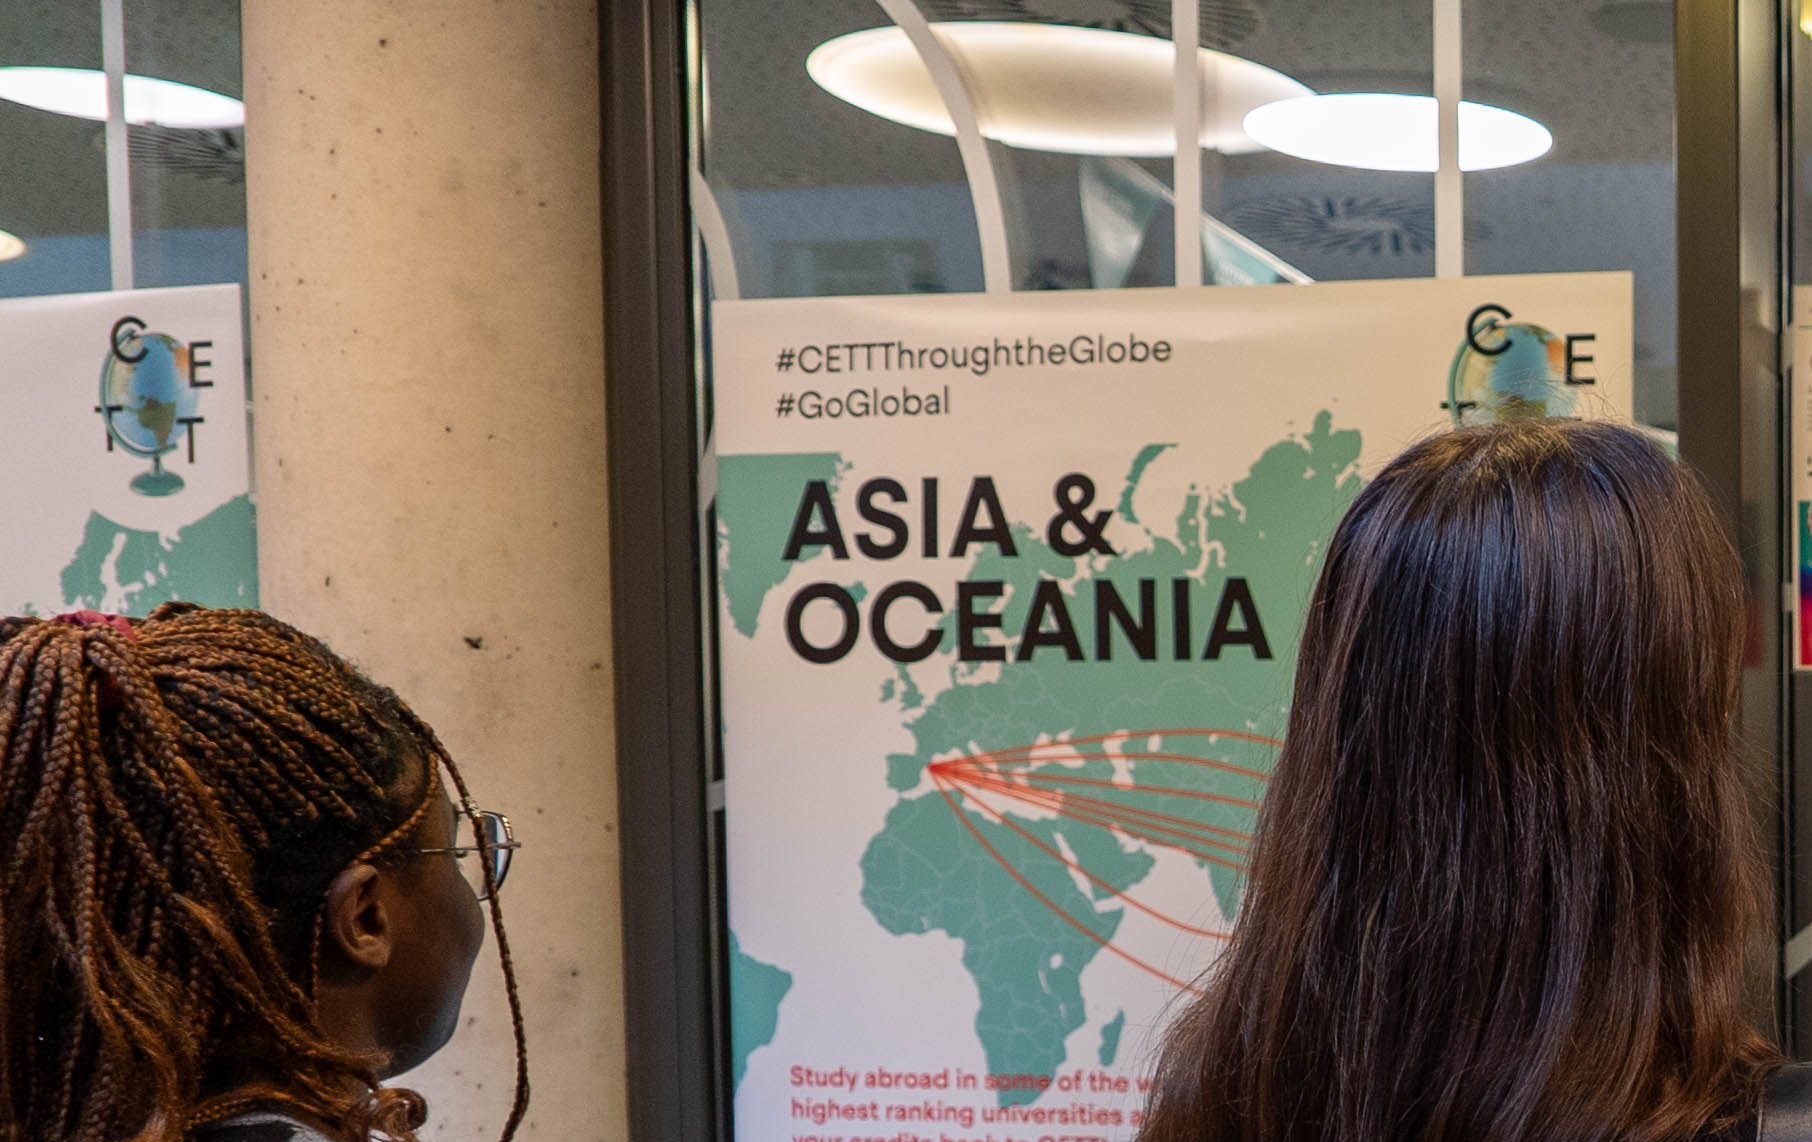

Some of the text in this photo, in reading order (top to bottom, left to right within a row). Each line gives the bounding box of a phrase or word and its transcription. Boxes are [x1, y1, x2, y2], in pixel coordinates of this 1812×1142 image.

[776, 334, 1173, 376] #CETTThroughtheGlobe
[776, 385, 950, 419] #GoGlobal
[781, 472, 1115, 562] ASIA &
[784, 575, 1275, 665] OCEANIA
[789, 1064, 858, 1093] Study
[864, 1067, 950, 1091] abroad
[956, 1068, 978, 1090] in
[984, 1072, 1052, 1092] some
[1057, 1068, 1084, 1092] of
[1088, 1070, 1130, 1093] the
[790, 1096, 880, 1126] highest
[885, 1099, 975, 1128] ranking
[981, 1101, 1124, 1126] universities
